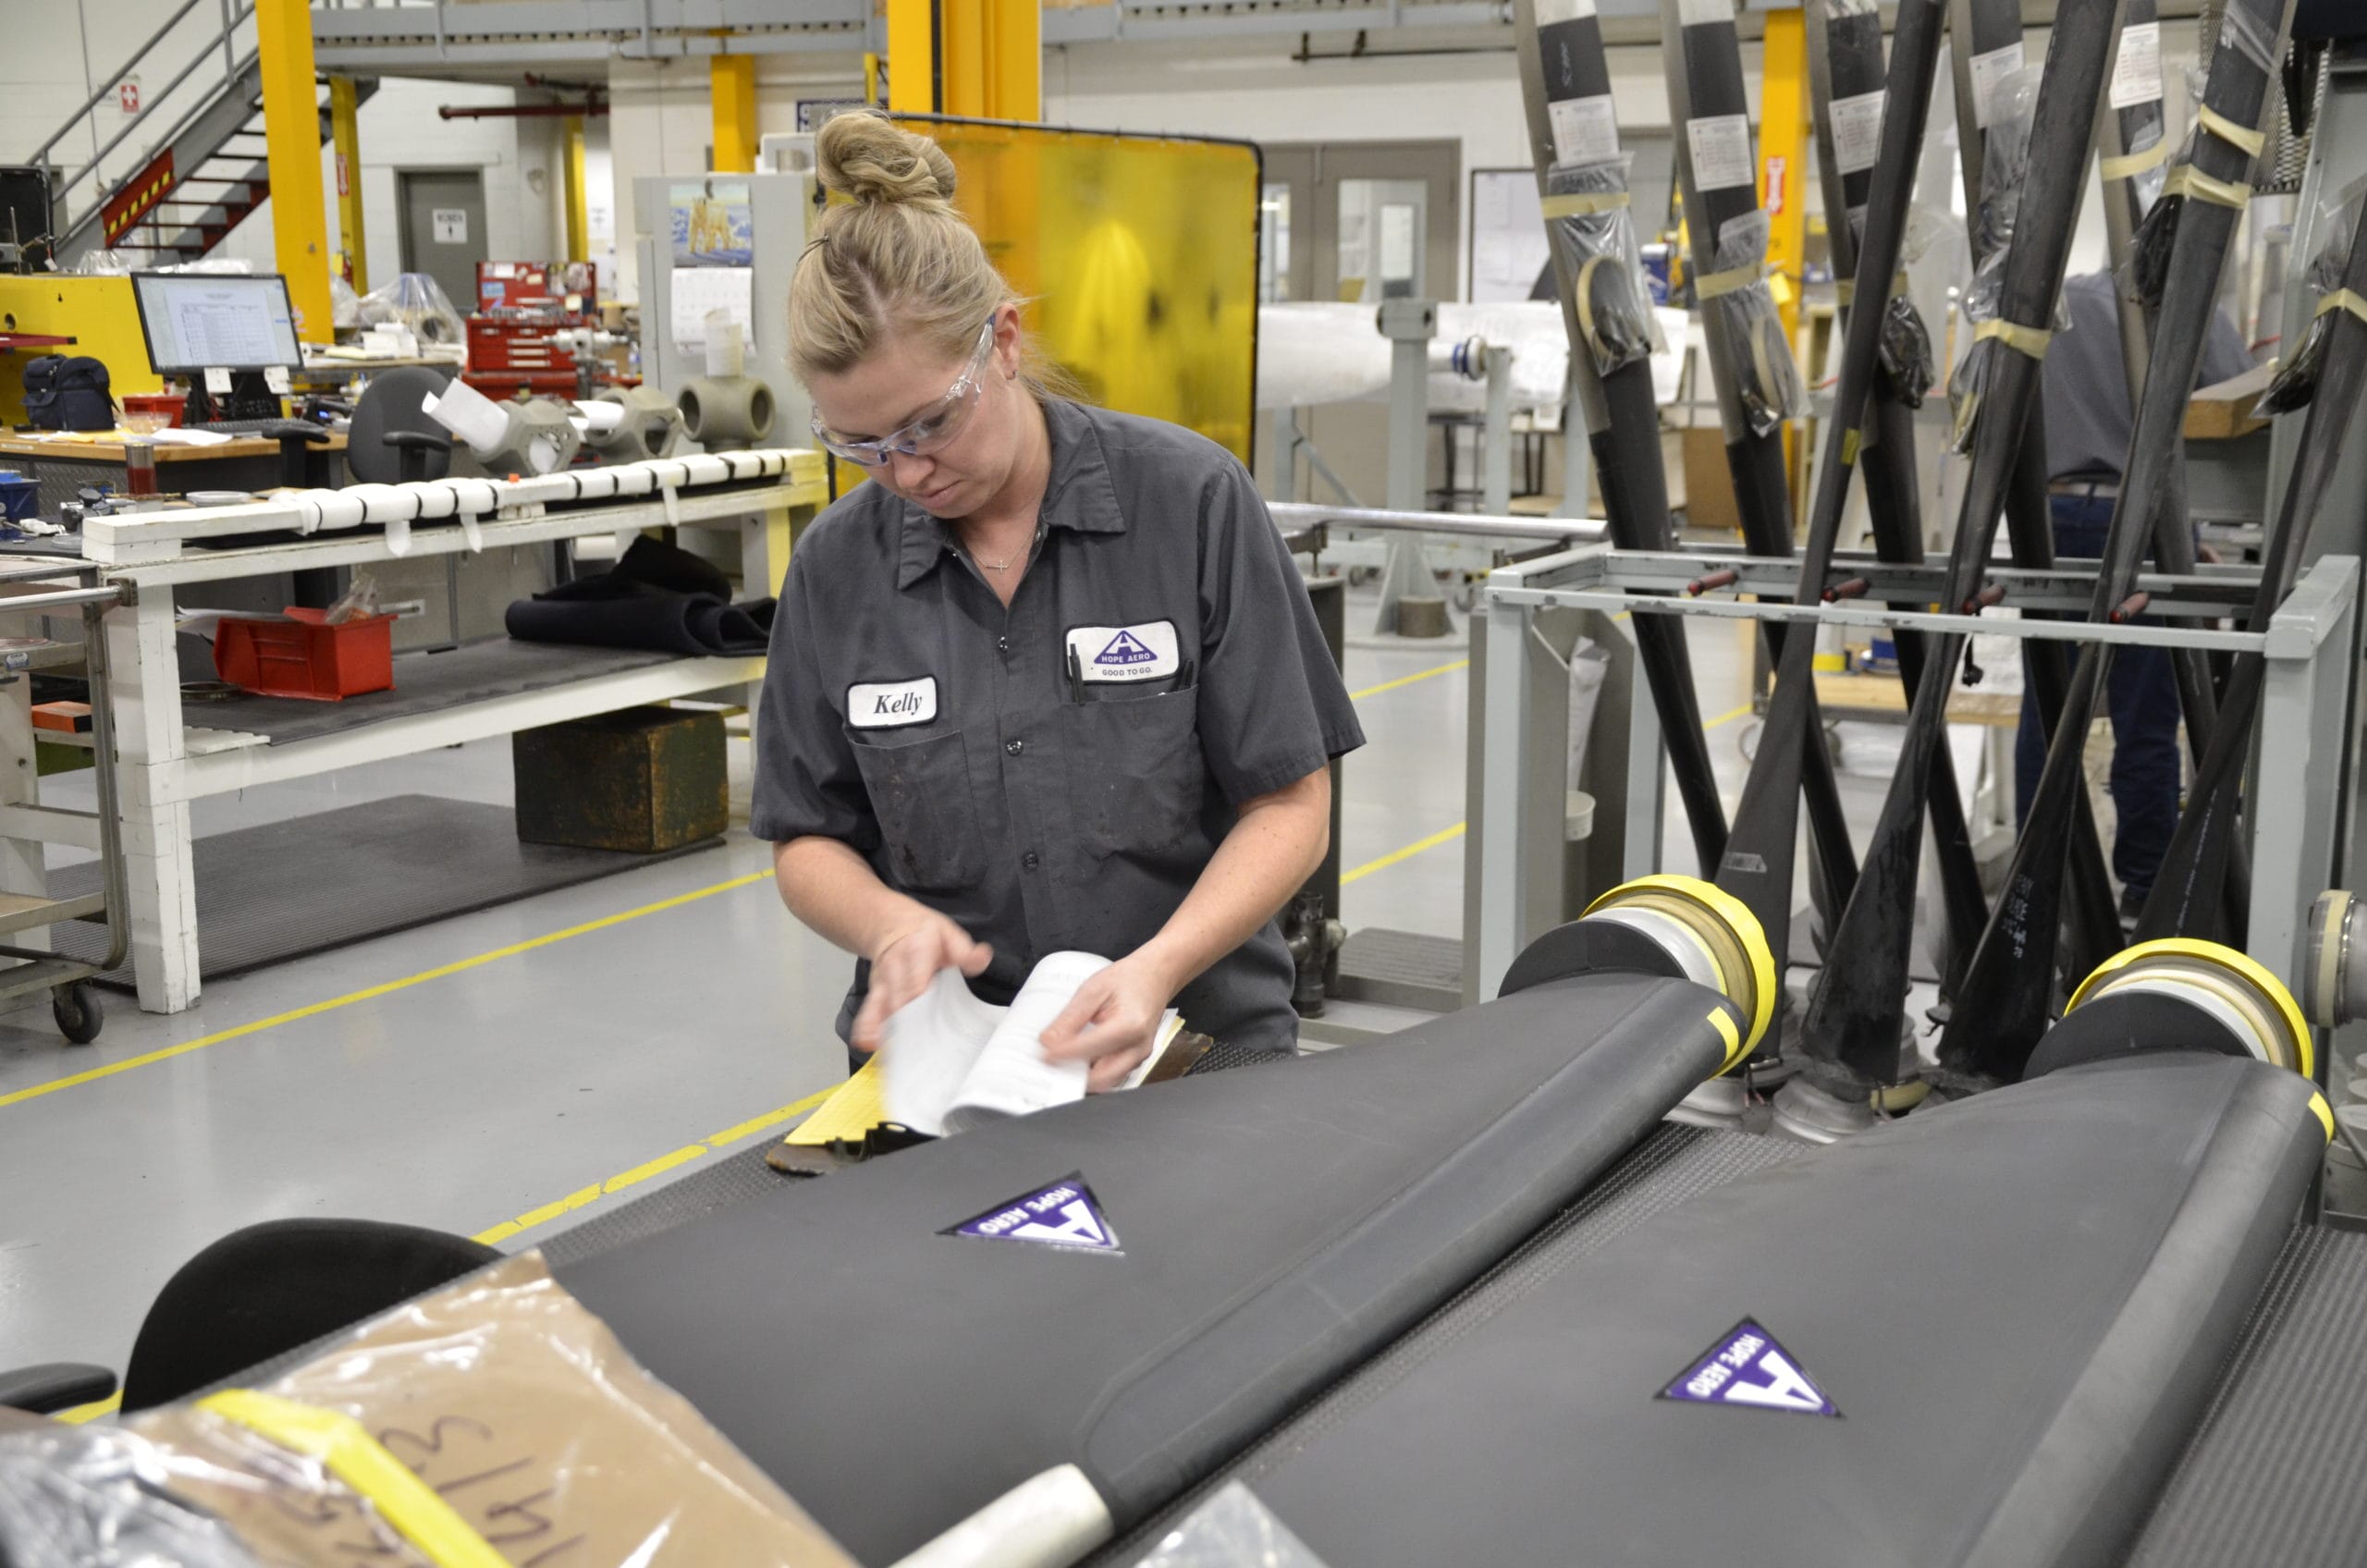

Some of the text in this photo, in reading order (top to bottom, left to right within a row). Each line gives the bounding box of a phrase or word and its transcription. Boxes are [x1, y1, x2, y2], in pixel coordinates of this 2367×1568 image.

[1101, 653, 1151, 664] HOPE AERO
[1102, 668, 1125, 677] GOOD
[1127, 668, 1138, 676] TO
[873, 692, 923, 716] Kelly
[977, 1186, 1078, 1234] HOPE AERO
[1686, 1333, 1766, 1398] HOPE AERO
